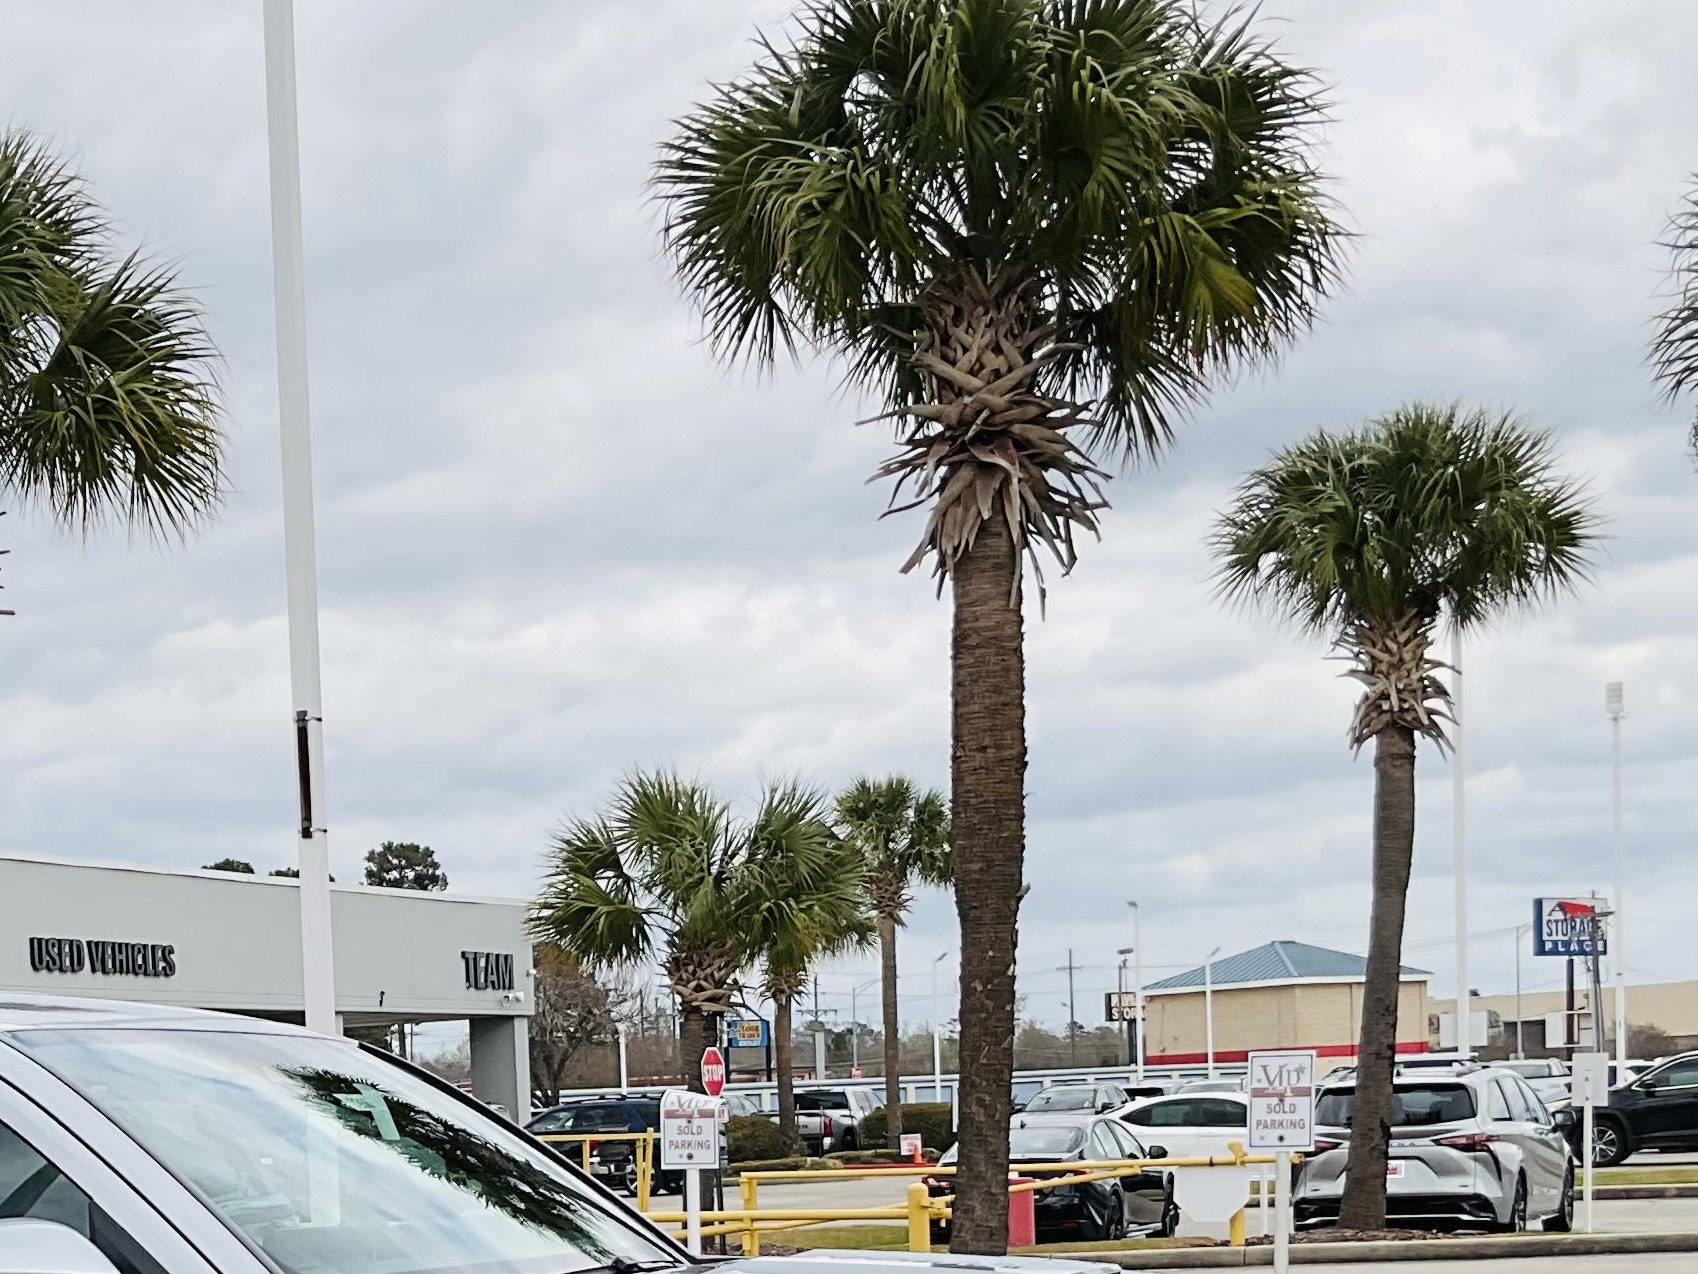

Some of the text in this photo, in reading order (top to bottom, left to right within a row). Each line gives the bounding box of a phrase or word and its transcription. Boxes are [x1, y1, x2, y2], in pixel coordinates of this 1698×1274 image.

[29, 937, 176, 977] USED VEHICLES
[461, 951, 514, 990] TEAM
[703, 1064, 724, 1082] STOP
[1266, 1103, 1296, 1114] SOLD
[1256, 1119, 1306, 1130] PARKING
[676, 1125, 703, 1136] SOLD
[668, 1140, 711, 1150] PARKING
